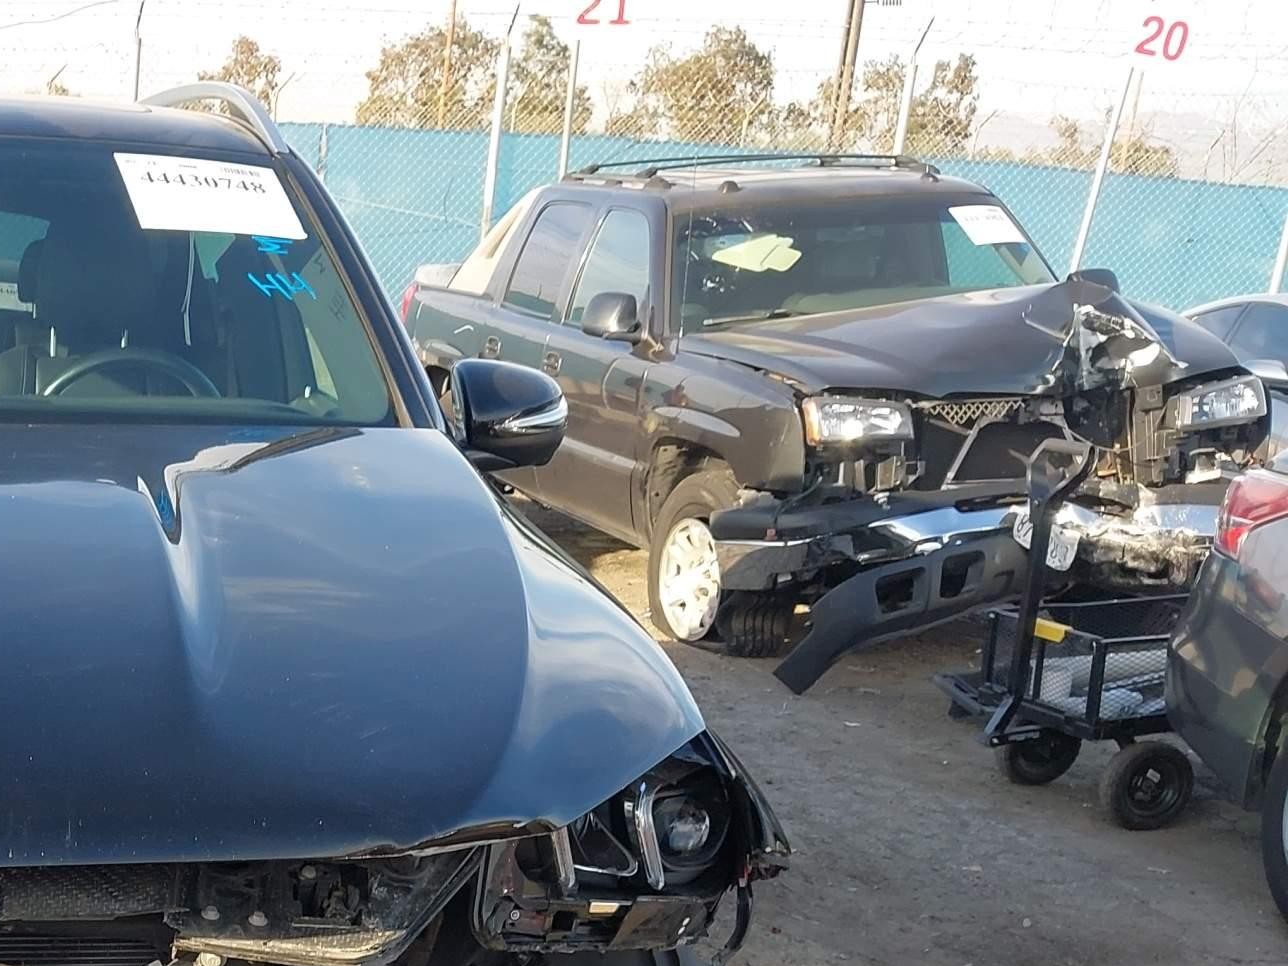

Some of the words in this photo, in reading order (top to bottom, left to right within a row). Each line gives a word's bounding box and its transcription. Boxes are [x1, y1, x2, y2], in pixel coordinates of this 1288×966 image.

[577, 0, 629, 24] 21
[1135, 15, 1188, 60] 20
[140, 171, 266, 194] 44430748
